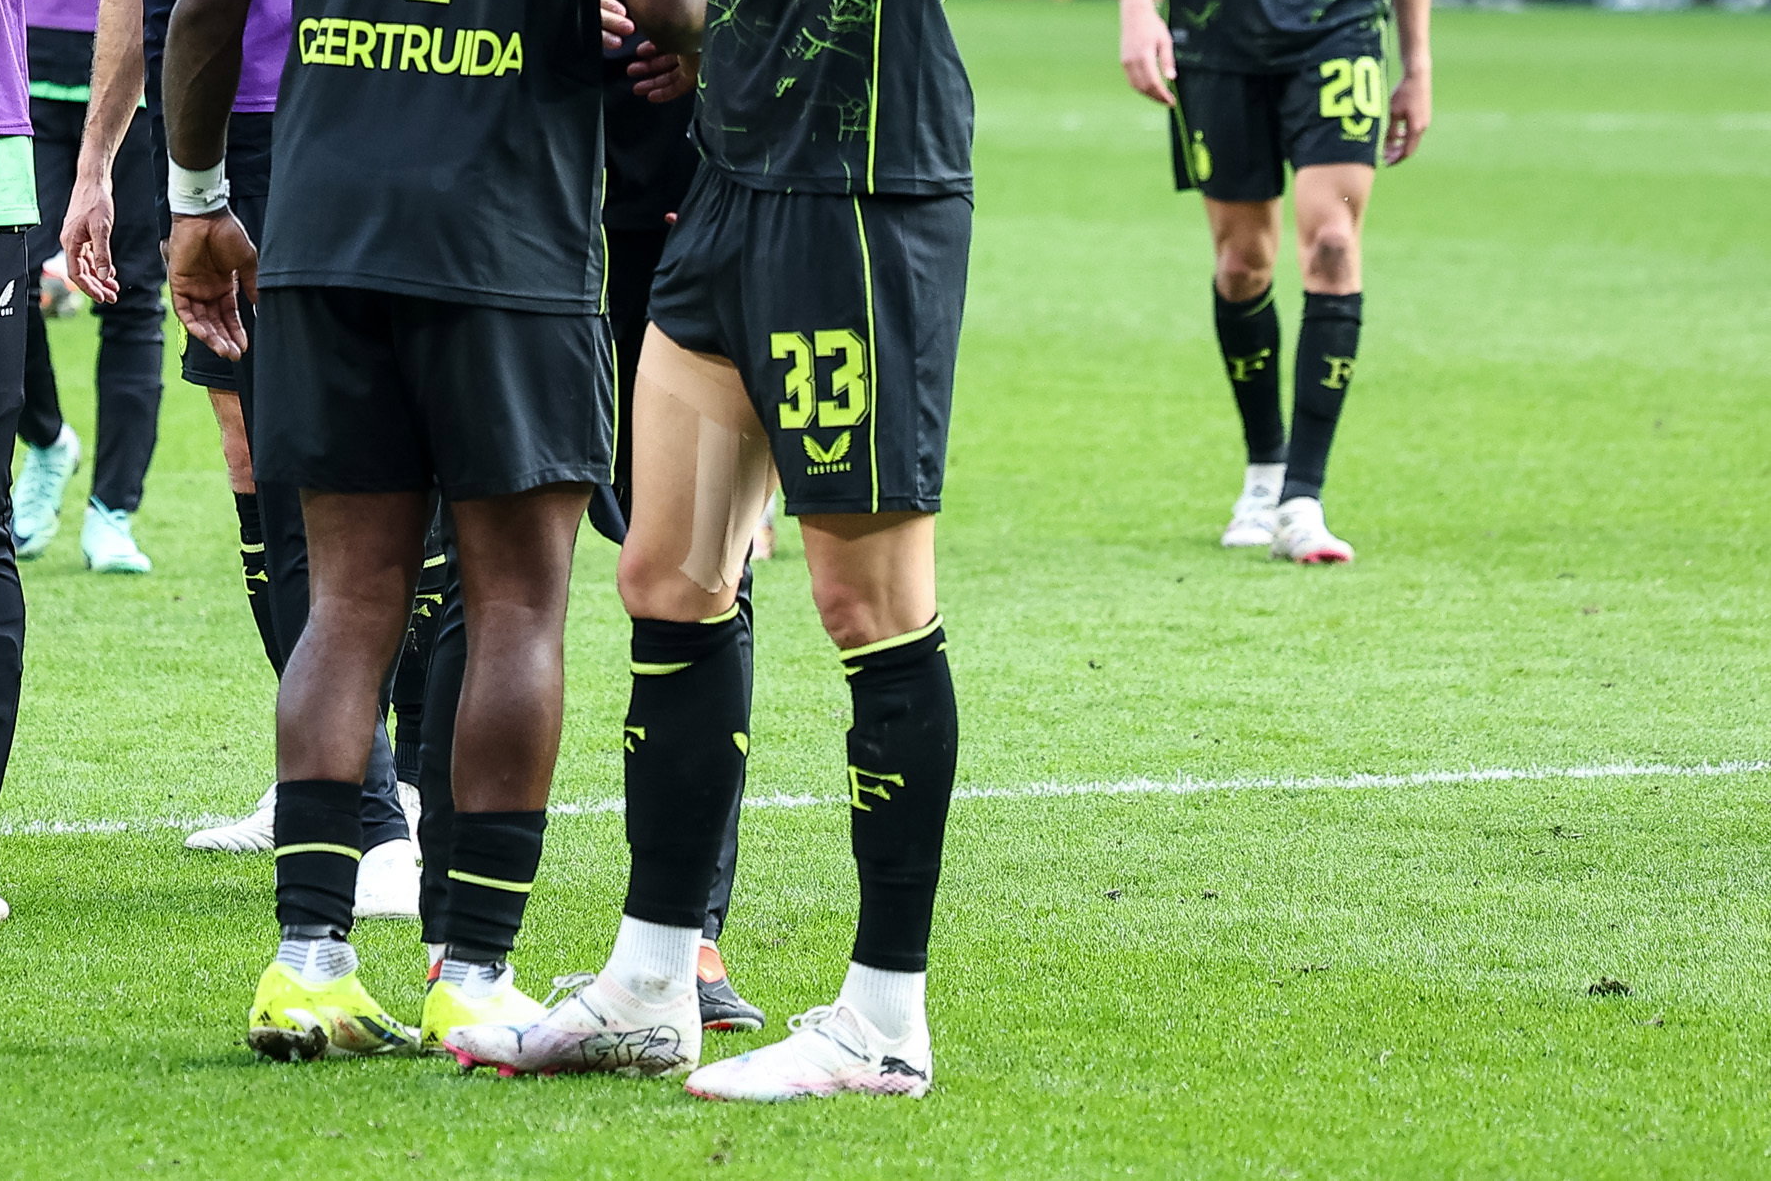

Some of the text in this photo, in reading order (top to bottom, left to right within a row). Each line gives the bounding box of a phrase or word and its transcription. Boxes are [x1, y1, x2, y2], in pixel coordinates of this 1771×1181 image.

[1319, 56, 1381, 119] 20
[770, 328, 871, 429] 33
[848, 765, 905, 812] F
